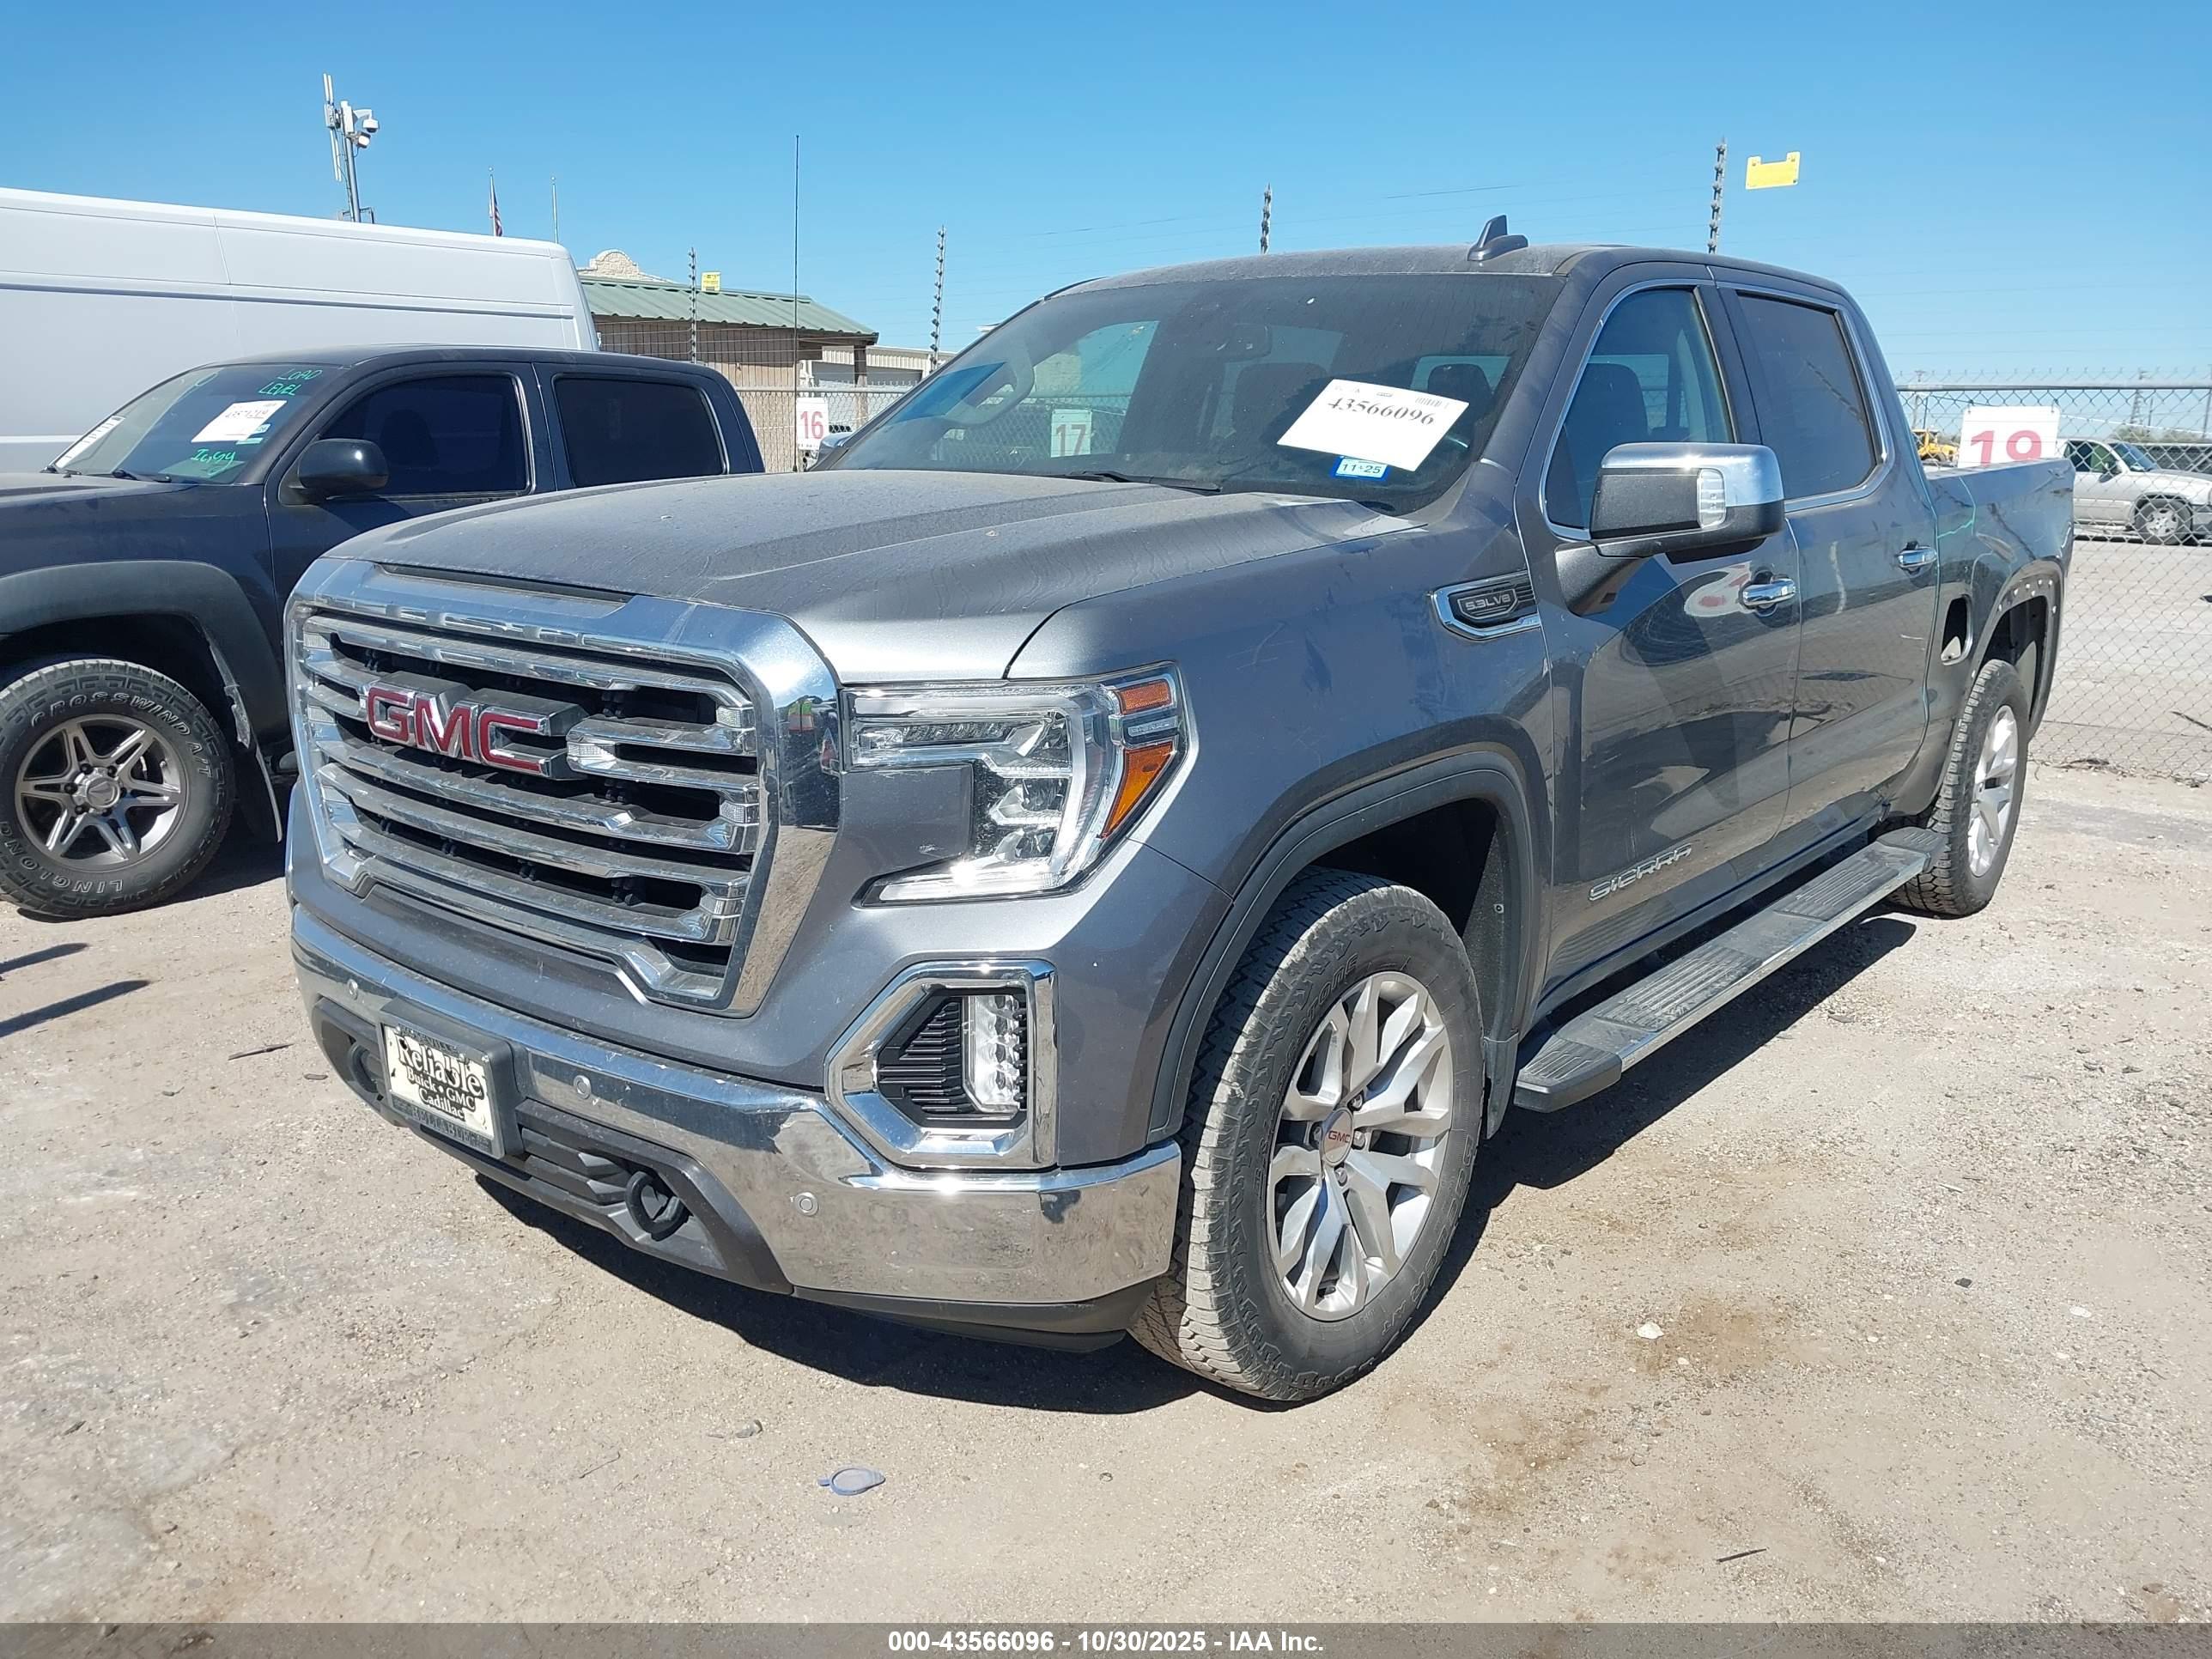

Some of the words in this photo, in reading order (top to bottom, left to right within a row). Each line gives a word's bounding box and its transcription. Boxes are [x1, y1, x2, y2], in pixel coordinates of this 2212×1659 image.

[258, 382, 301, 396] LEVEL
[276, 368, 322, 380] LOAD
[800, 410, 824, 440] 16
[1328, 397, 1435, 426] 43566096
[1056, 423, 1086, 457] 17
[1970, 429, 2042, 468] 19
[31, 690, 191, 736] CROSSWIND
[185, 739, 213, 778] A/T
[367, 682, 552, 778] GMC
[1589, 842, 1692, 902] SIERRA
[396, 1035, 484, 1099] Reliable
[408, 1066, 436, 1093] Buick
[446, 1086, 477, 1111] GMC
[418, 1087, 465, 1120] Cadillac
[1328, 1130, 1351, 1144] GMC
